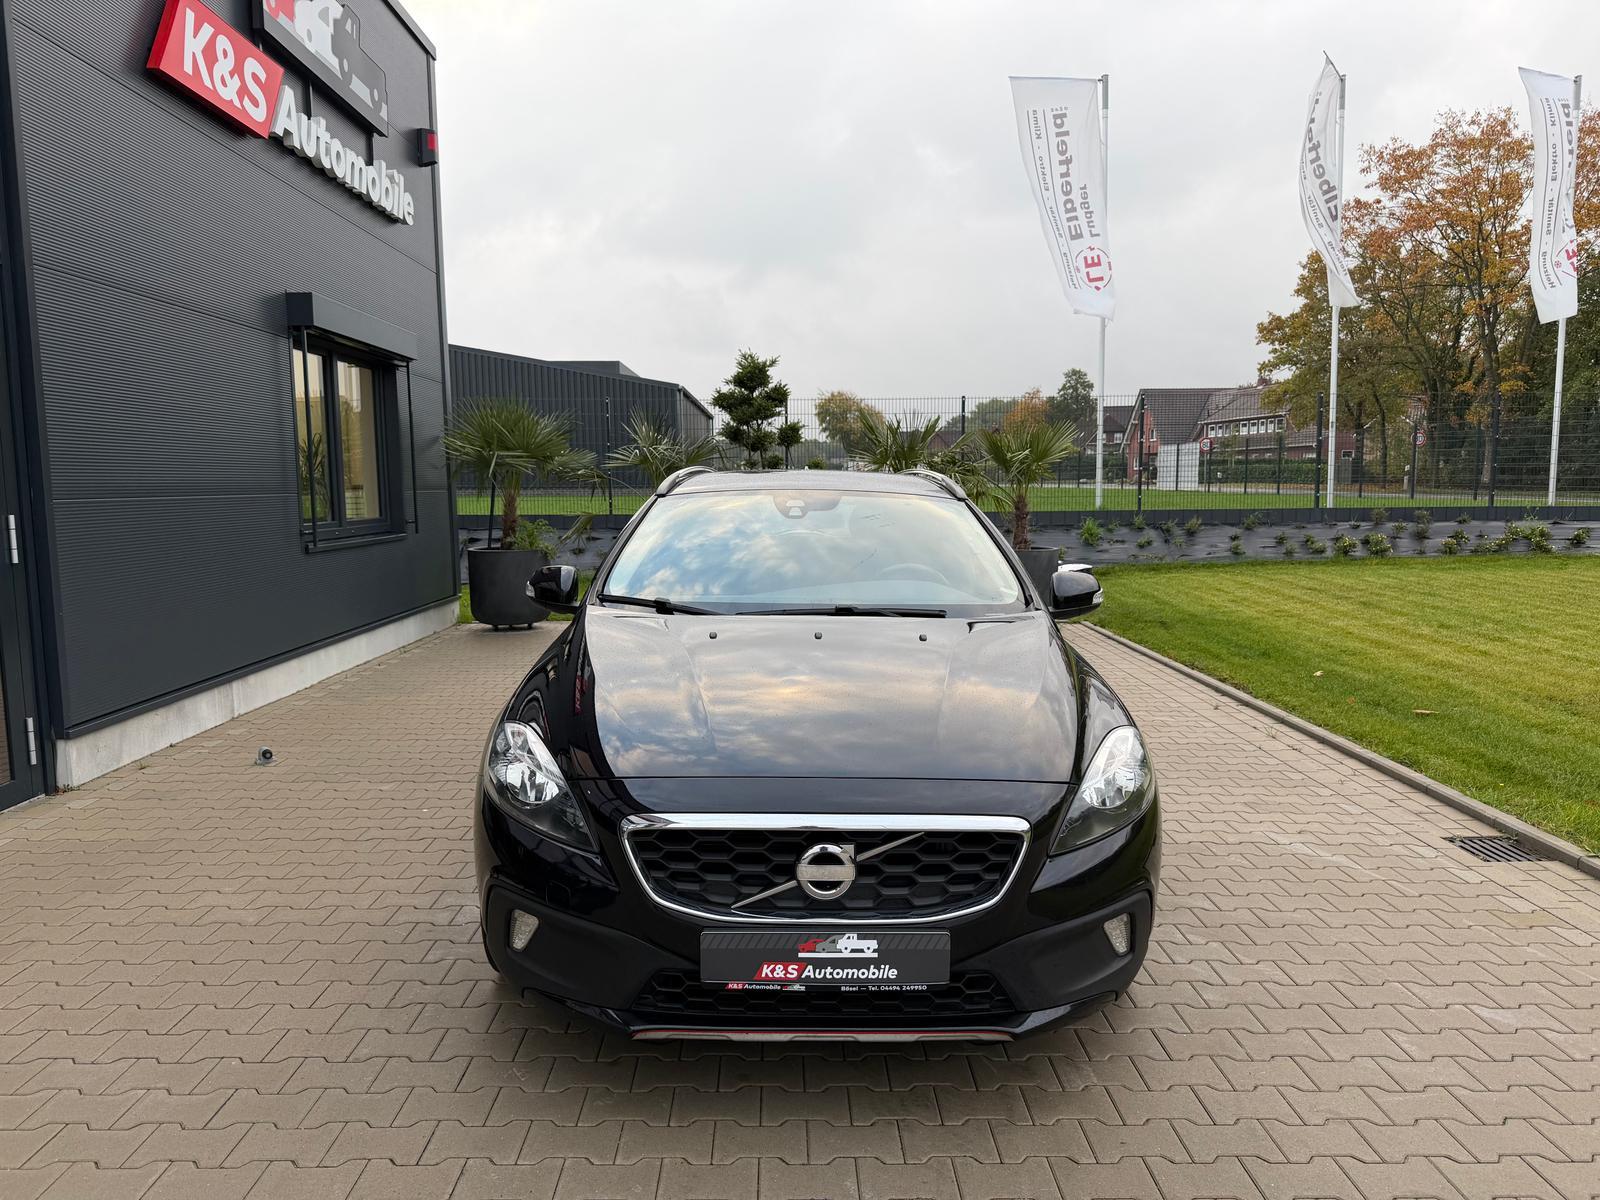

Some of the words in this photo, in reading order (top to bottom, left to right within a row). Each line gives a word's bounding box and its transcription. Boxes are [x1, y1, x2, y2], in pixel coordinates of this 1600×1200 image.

[184, 7, 267, 122] K&S
[271, 84, 415, 226] Automobile
[761, 964, 798, 978] K&S
[801, 964, 898, 979] Automobile
